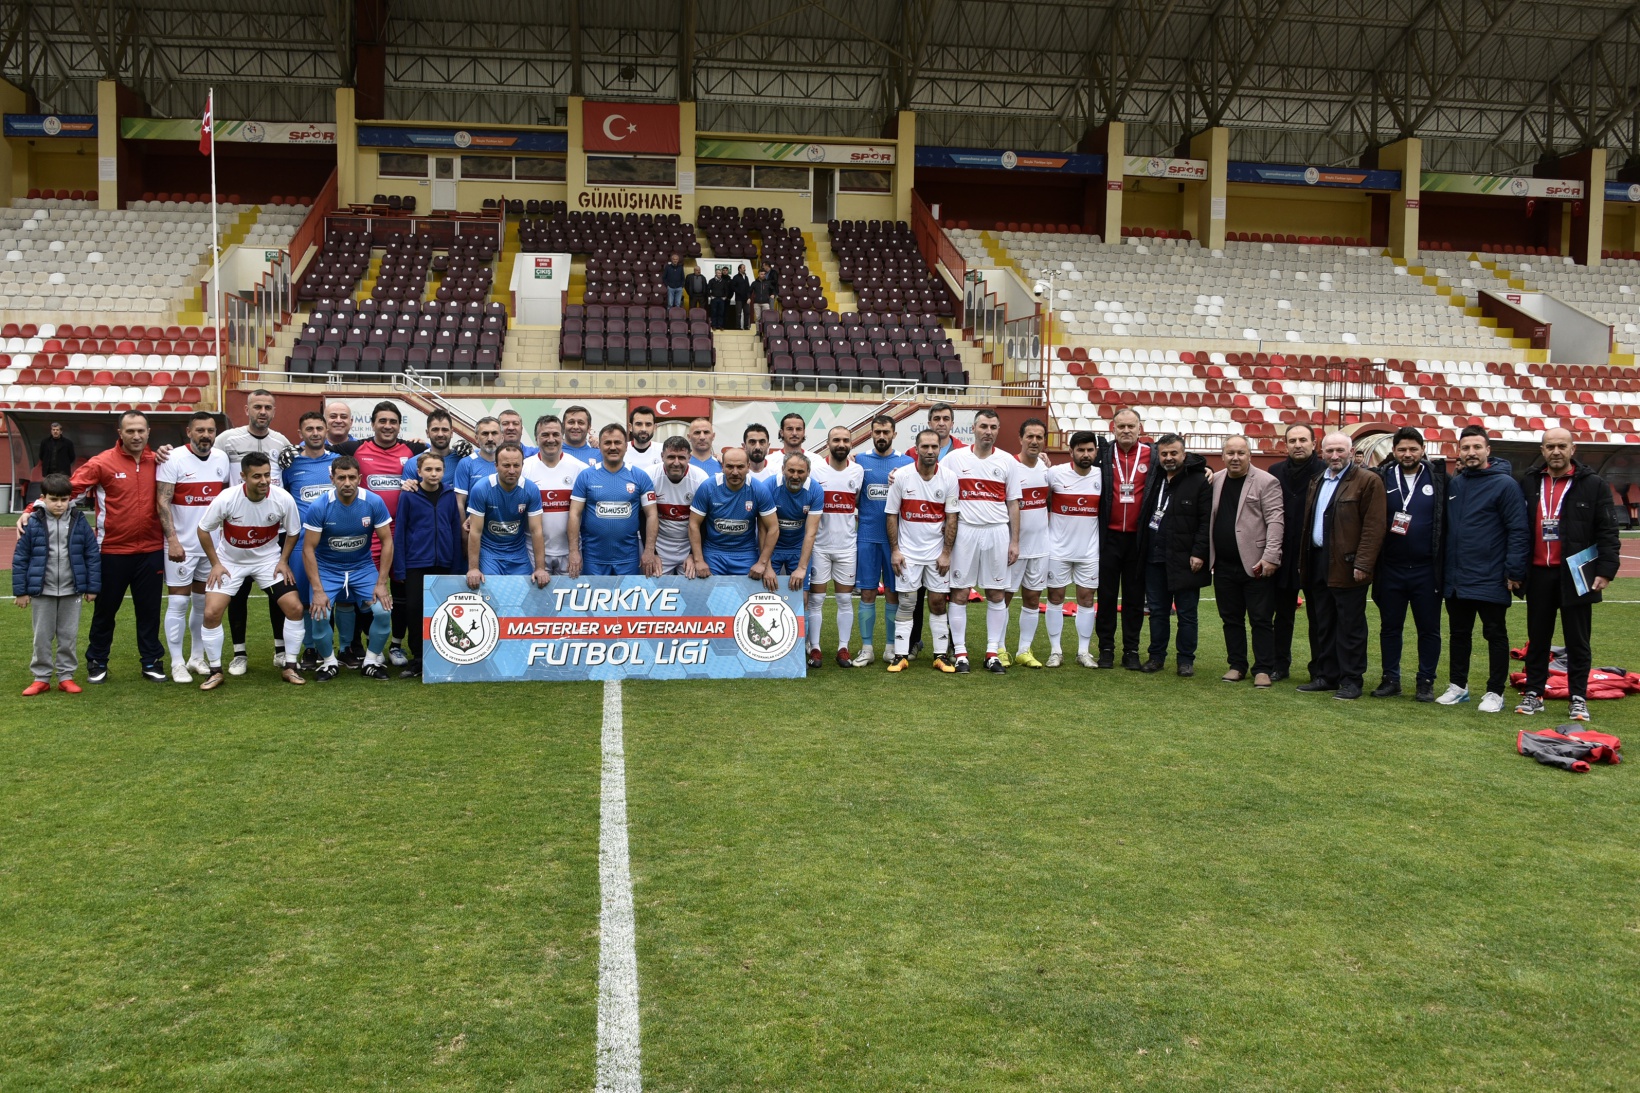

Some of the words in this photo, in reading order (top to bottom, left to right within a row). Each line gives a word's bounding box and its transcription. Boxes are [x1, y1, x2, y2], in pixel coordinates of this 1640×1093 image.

[288, 131, 335, 140] SPOR
[850, 152, 892, 160] SPOR
[1168, 166, 1204, 175] SPOR
[1546, 187, 1580, 195] SPOR
[578, 187, 682, 210] GÜMÜŞHANE
[507, 622, 600, 635] MASTERLER
[603, 622, 623, 635] ve
[627, 621, 726, 634] VETERANLAR
[527, 641, 644, 666] FUTBOL
